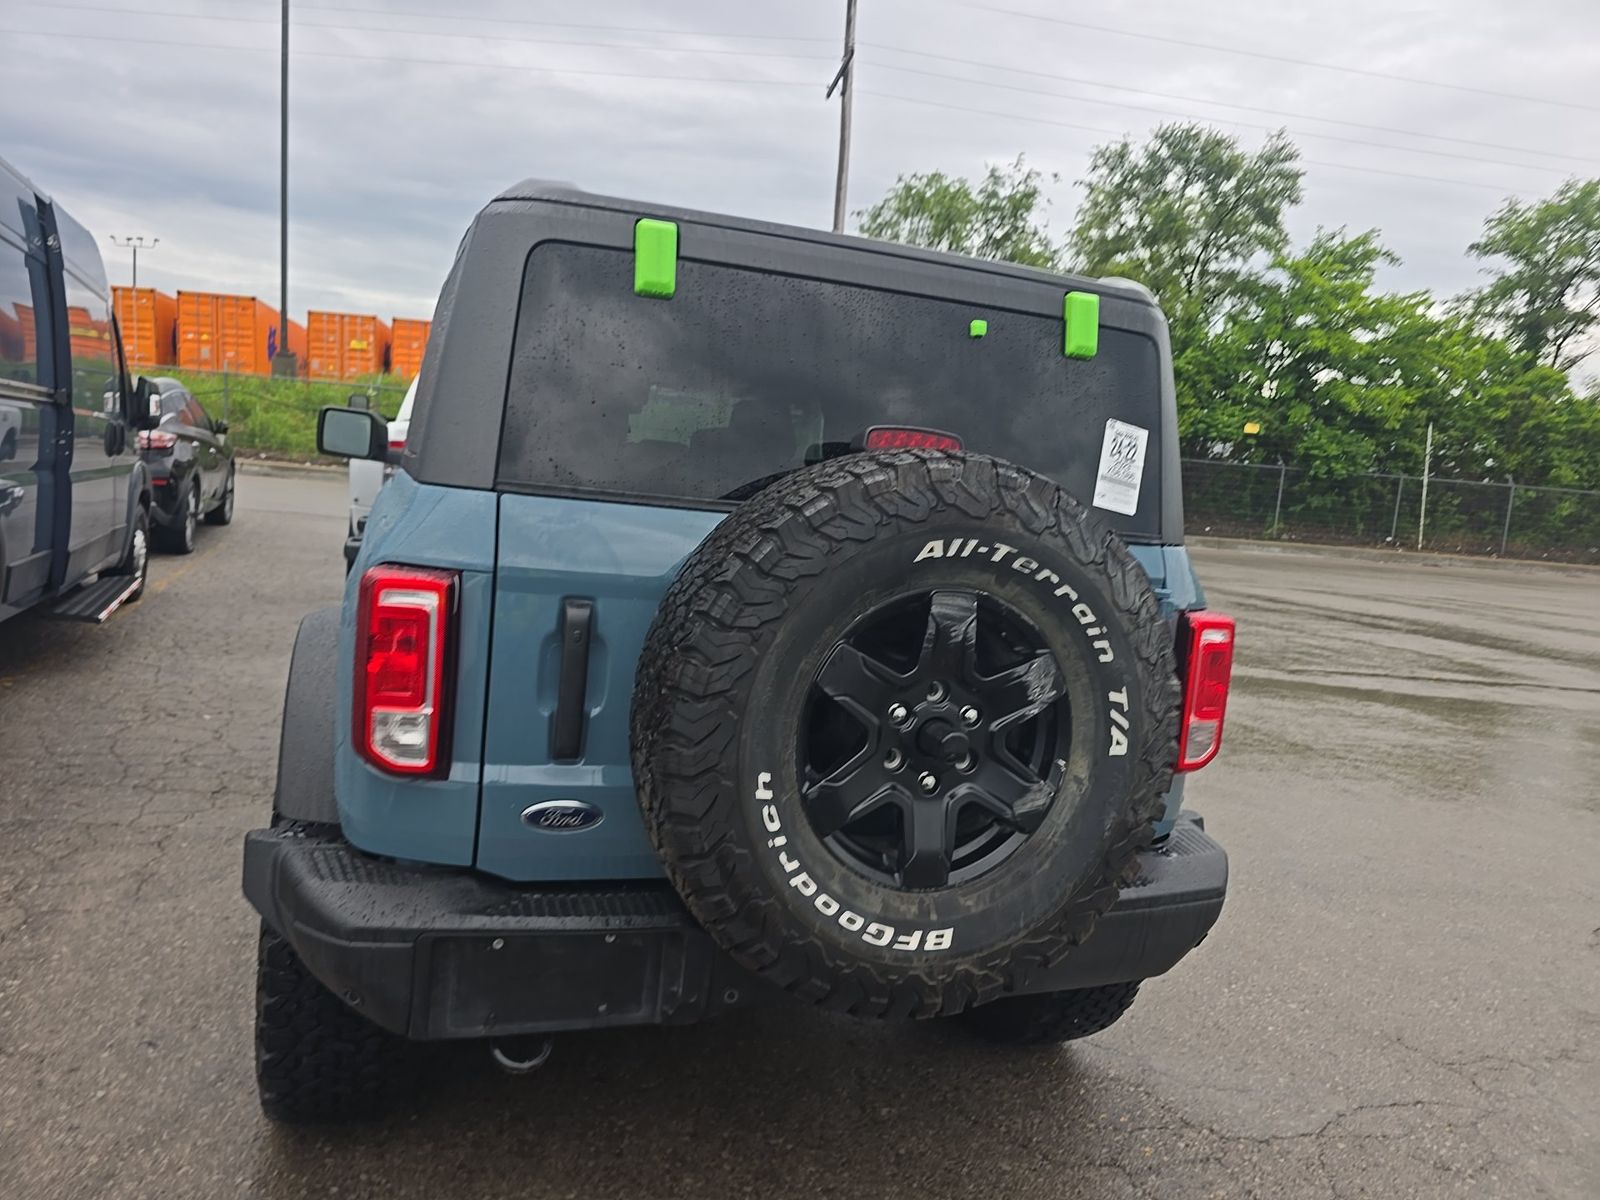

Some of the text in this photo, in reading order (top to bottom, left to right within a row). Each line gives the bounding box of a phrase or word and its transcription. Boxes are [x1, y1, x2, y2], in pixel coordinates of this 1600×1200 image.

[913, 538, 1130, 757] All-Terrain T/A
[540, 807, 585, 827] Ford
[755, 771, 954, 951] BFGoodrich
